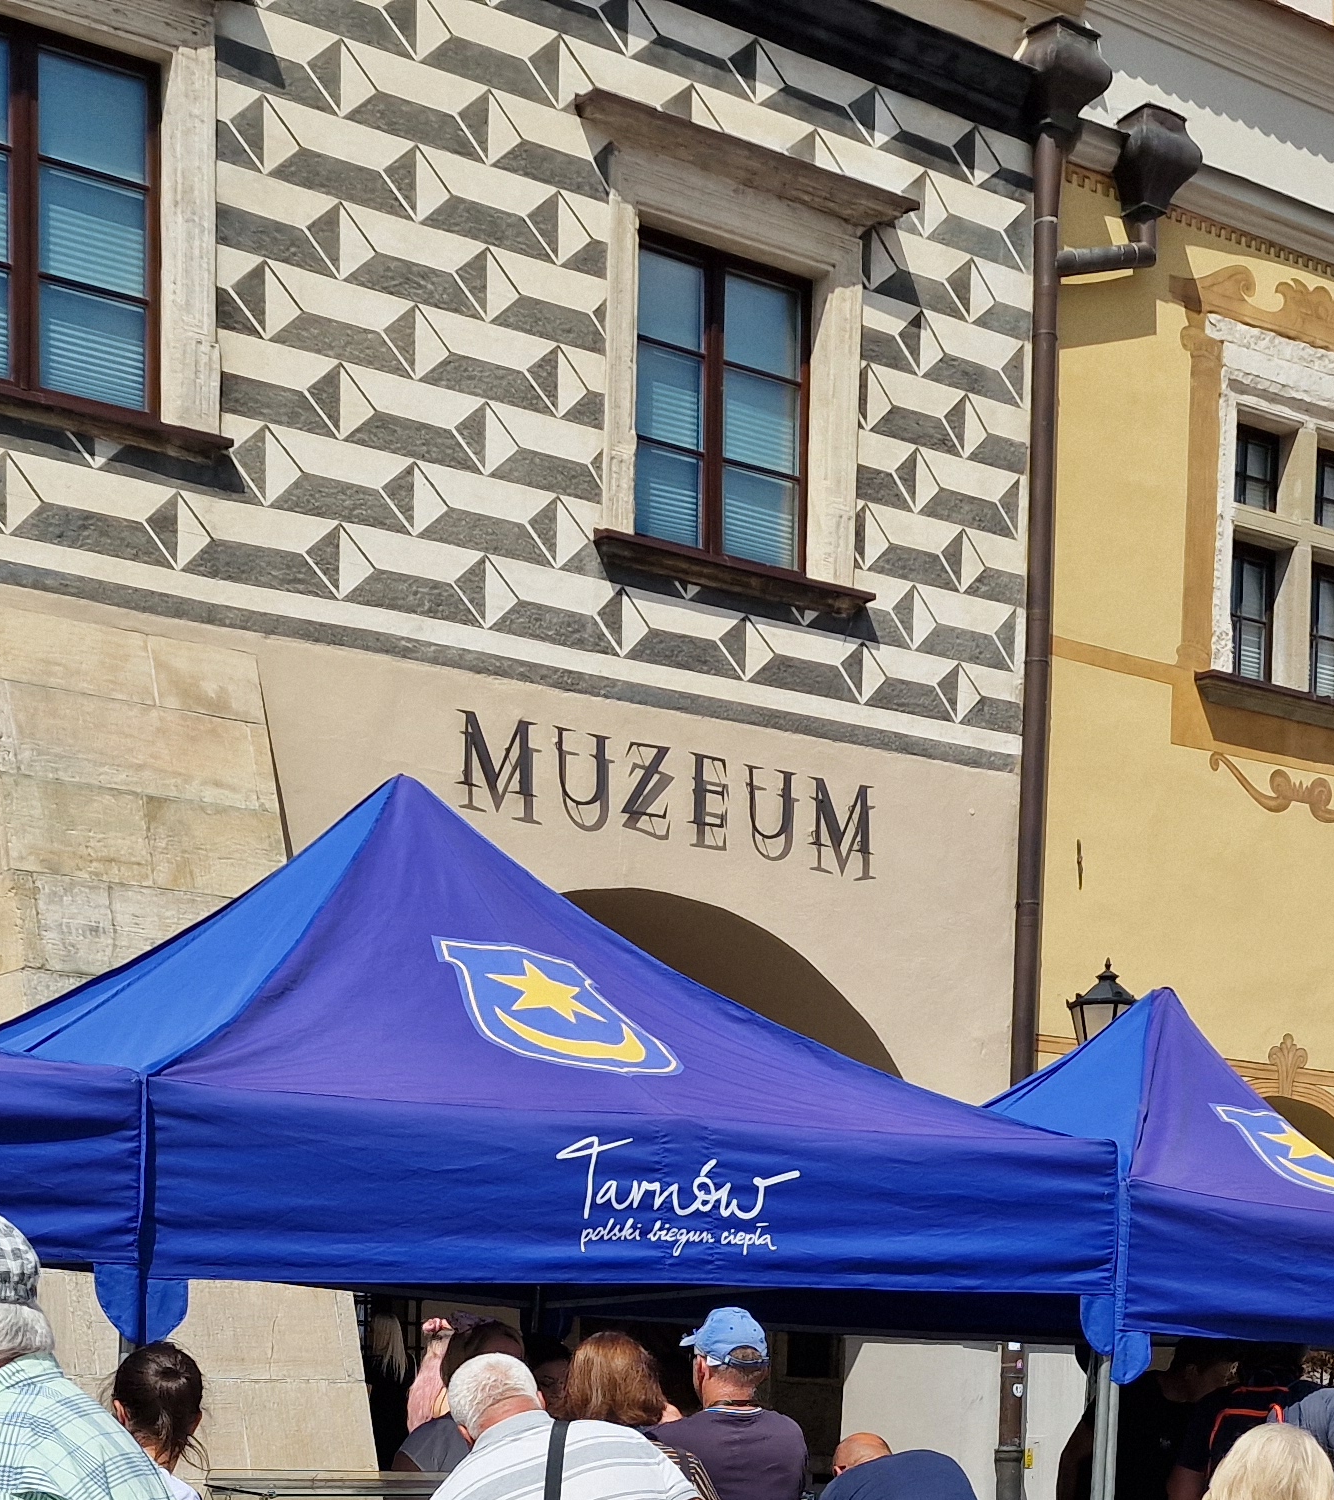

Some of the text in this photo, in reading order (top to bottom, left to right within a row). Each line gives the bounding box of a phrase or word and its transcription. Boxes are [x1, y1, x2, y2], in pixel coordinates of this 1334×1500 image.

[454, 708, 875, 858] MUZEUM
[556, 1136, 801, 1220] Tarnów
[580, 1218, 778, 1257] polski biegun ciepła
